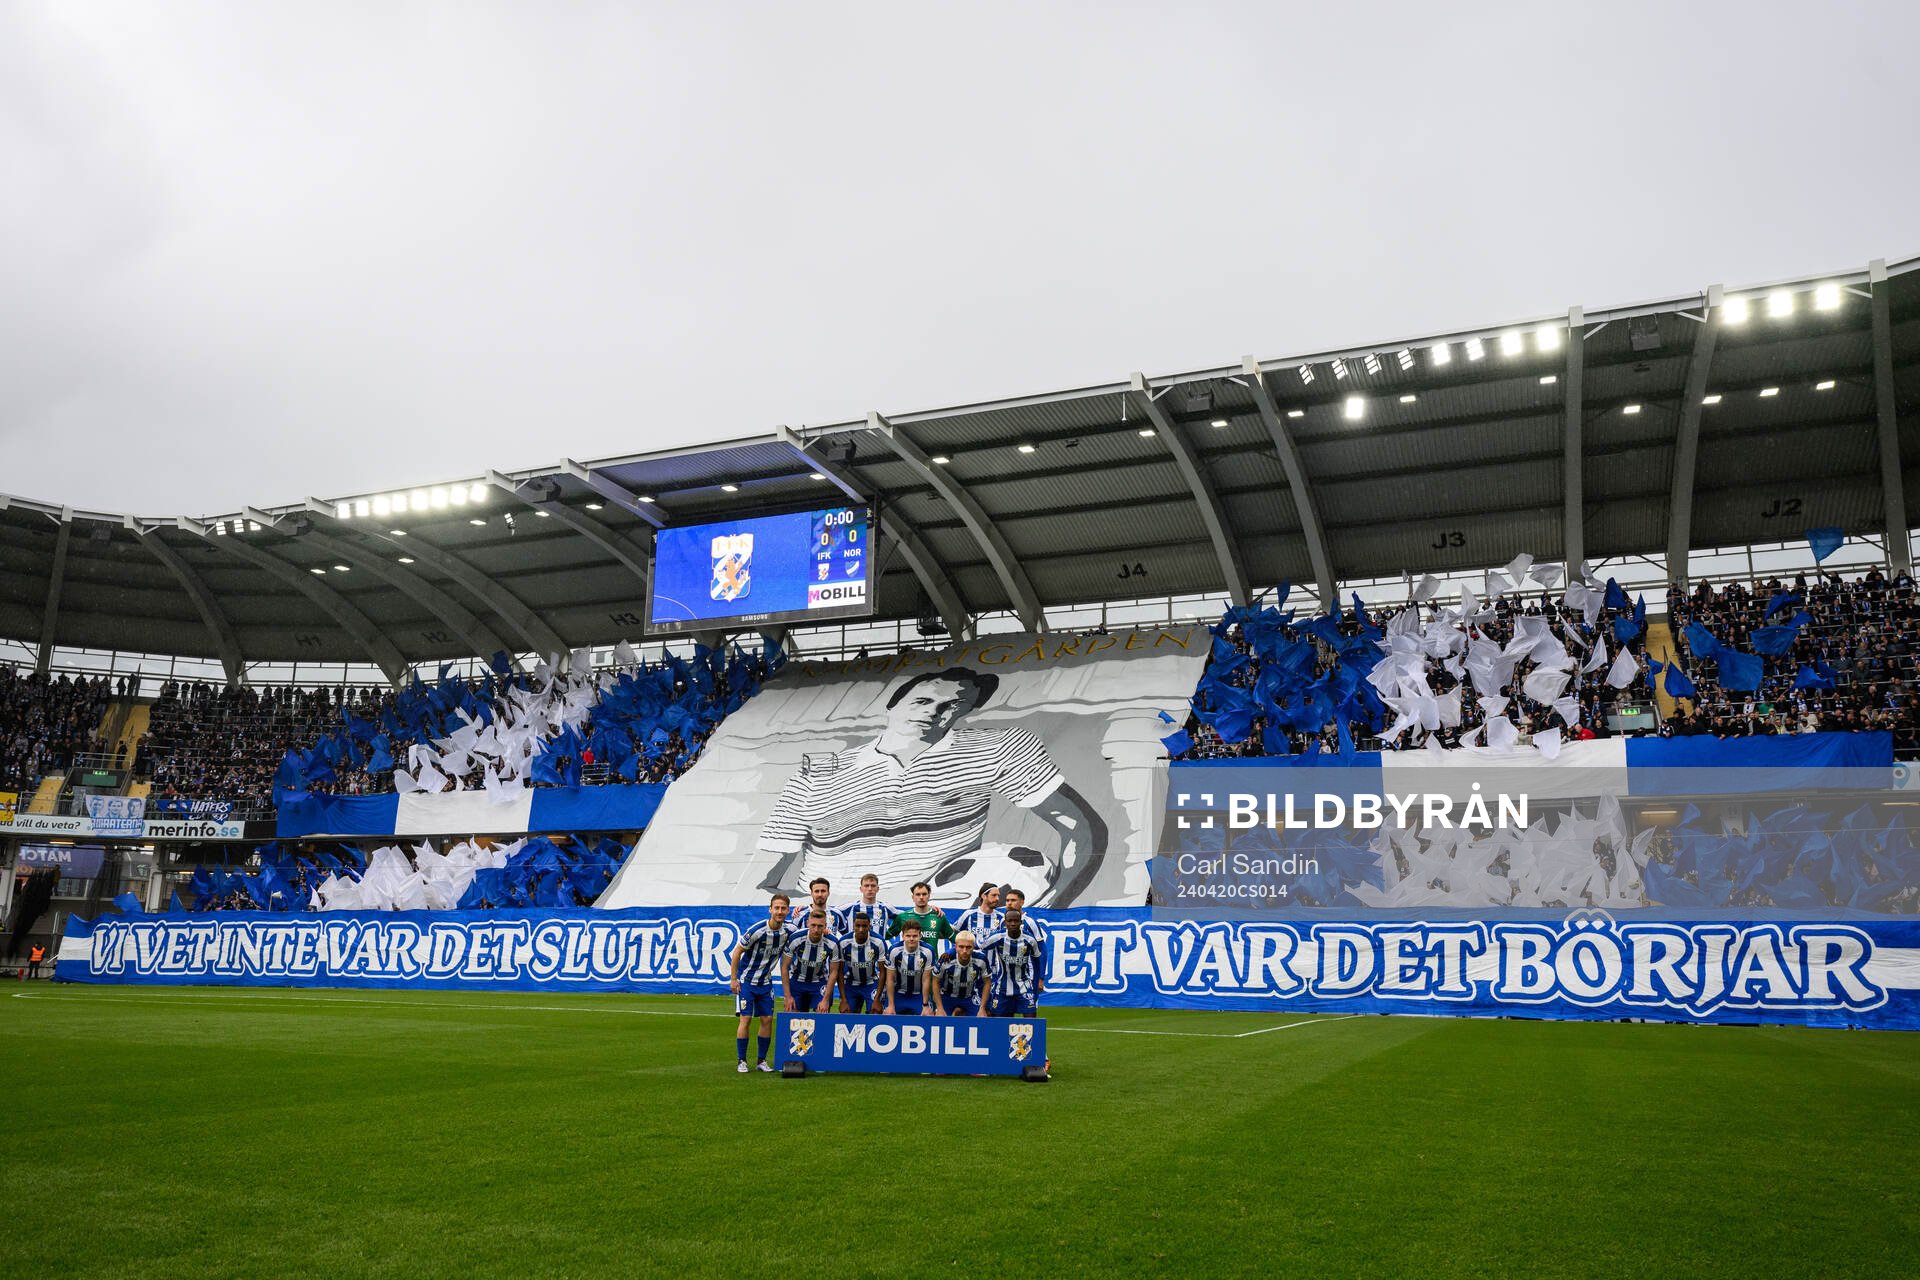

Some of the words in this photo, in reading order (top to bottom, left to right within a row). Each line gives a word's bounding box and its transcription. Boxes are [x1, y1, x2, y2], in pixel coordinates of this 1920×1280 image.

[1761, 498, 1802, 518] J2
[825, 511, 854, 526] 0:00
[821, 533, 829, 546] 0
[849, 529, 857, 543] 0
[1431, 531, 1466, 549] J3
[817, 551, 832, 561] IFK
[843, 548, 861, 558] NOR
[1117, 563, 1148, 579] J4
[808, 586, 866, 603] MOBILL
[610, 612, 640, 627] H3
[190, 801, 231, 813] HATERS
[16, 819, 33, 828] vill
[35, 819, 49, 828] du
[51, 820, 81, 830] veta?
[148, 822, 240, 837] merinfo.se
[91, 923, 131, 972] VI
[132, 922, 216, 973] VET
[216, 921, 322, 974] INTE
[326, 921, 420, 977] VAR
[426, 920, 529, 977] DET
[531, 919, 740, 980] SLUTAR
[1048, 924, 1133, 989] ET
[1146, 924, 1303, 996] VAR
[1315, 924, 1488, 996] DET
[1497, 914, 1882, 1010] BÖRJAR
[833, 1023, 989, 1058] MOBILL
